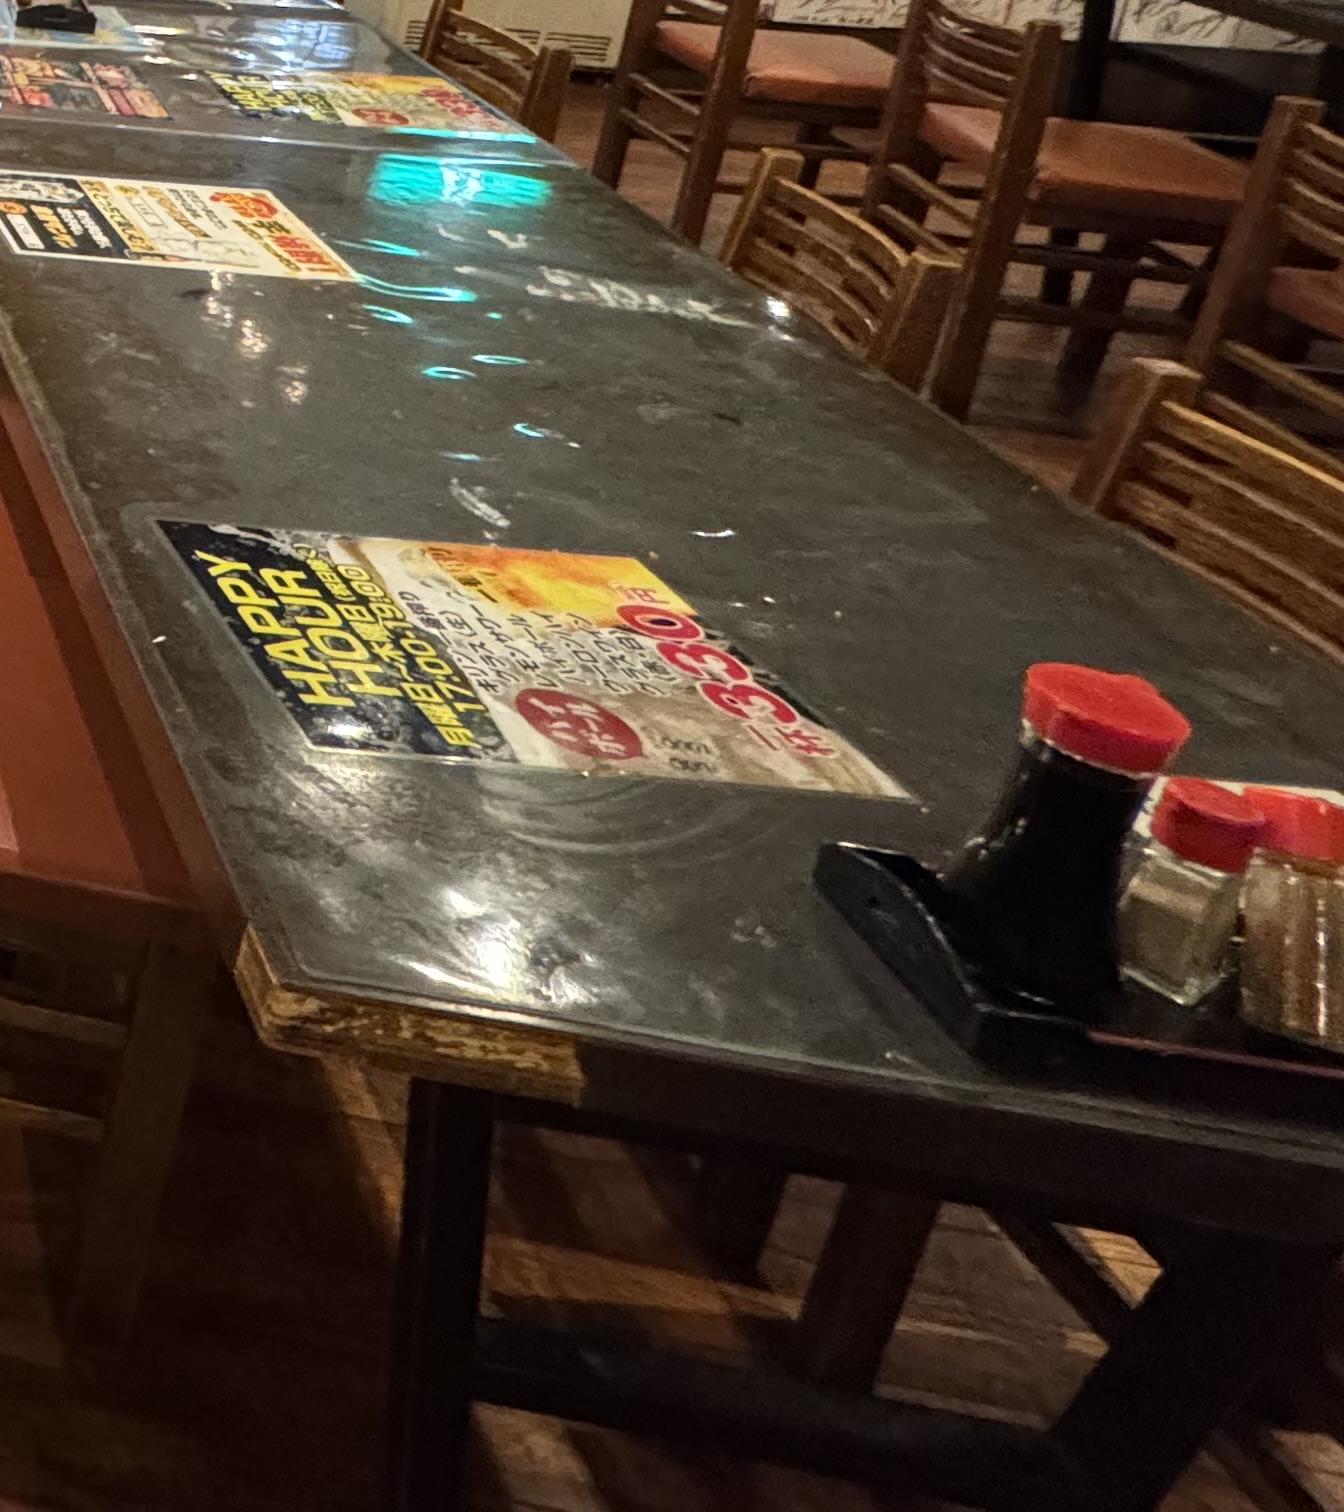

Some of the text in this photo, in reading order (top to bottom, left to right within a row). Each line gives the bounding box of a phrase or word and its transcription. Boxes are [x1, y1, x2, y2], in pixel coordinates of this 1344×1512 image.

[194, 548, 356, 707] HAPPY
[260, 566, 404, 697] HOUR
[336, 563, 487, 714] 17:00-19:00
[471, 603, 559, 688] レモンサワー
[507, 610, 587, 685] ハイボール
[529, 609, 631, 695] ウーロンハイ
[565, 611, 666, 697] グラスワイン
